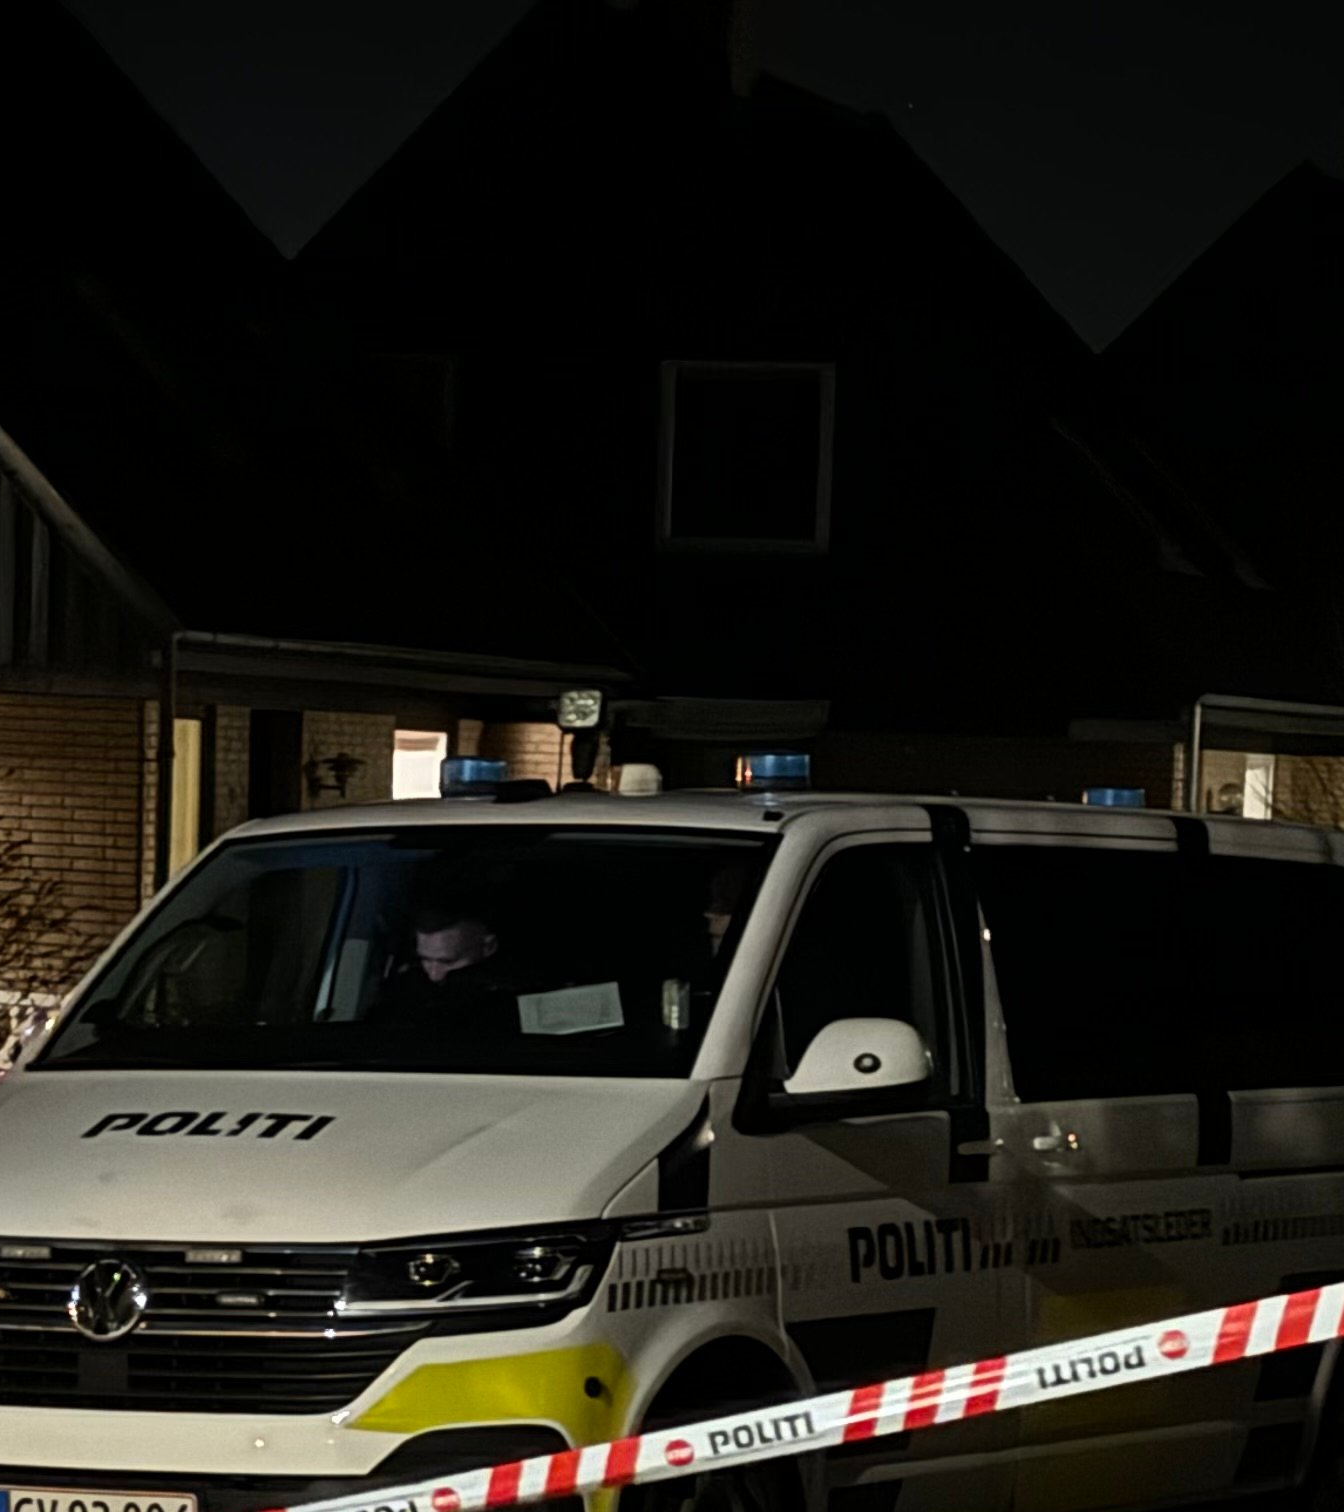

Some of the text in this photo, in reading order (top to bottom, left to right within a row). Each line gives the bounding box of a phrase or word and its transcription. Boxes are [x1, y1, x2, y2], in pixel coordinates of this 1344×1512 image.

[80, 1111, 337, 1141] POLITI
[847, 1218, 972, 1283] POLITI
[1036, 1345, 1146, 1389] POLITI
[708, 1410, 816, 1455] POLITI
